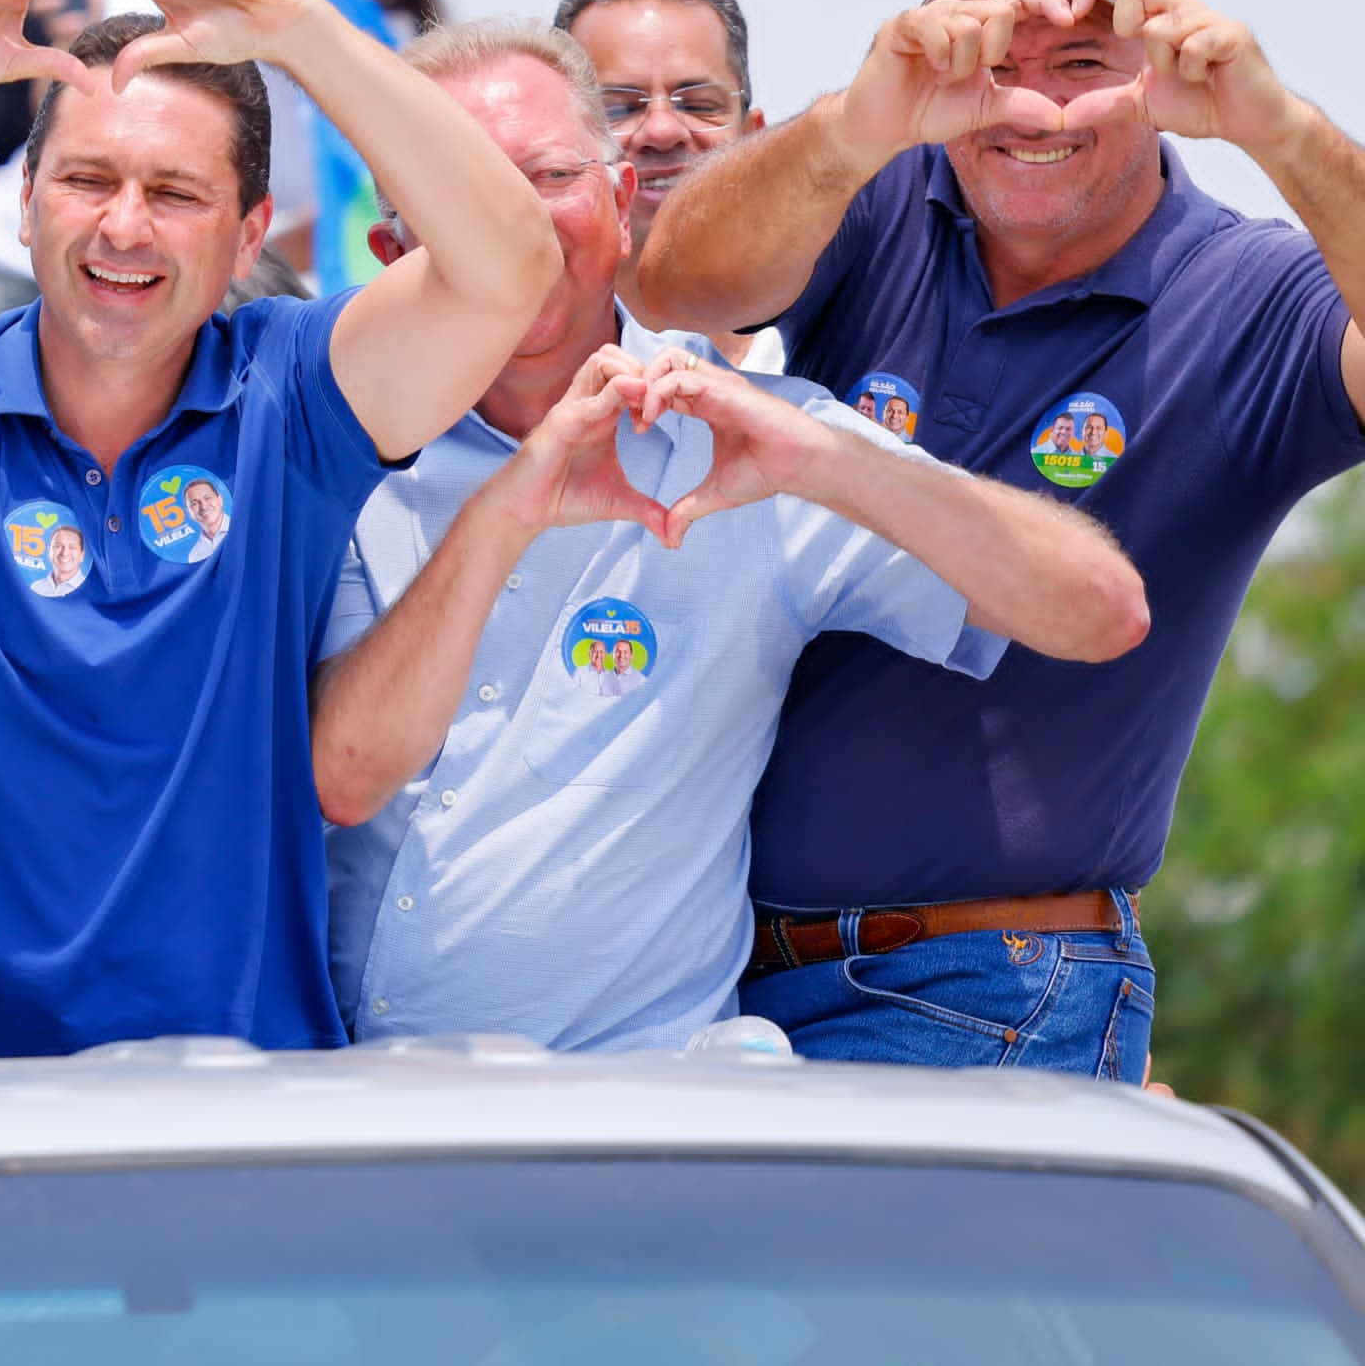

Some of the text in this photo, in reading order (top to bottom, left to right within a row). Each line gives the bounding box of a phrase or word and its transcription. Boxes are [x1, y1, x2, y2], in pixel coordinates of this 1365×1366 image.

[1043, 455, 1082, 467] 15015
[1092, 461, 1107, 473] 15
[142, 496, 185, 533] 15
[9, 525, 45, 557] 15
[154, 525, 196, 547] VILELA
[582, 620, 642, 635] VILELA 15
